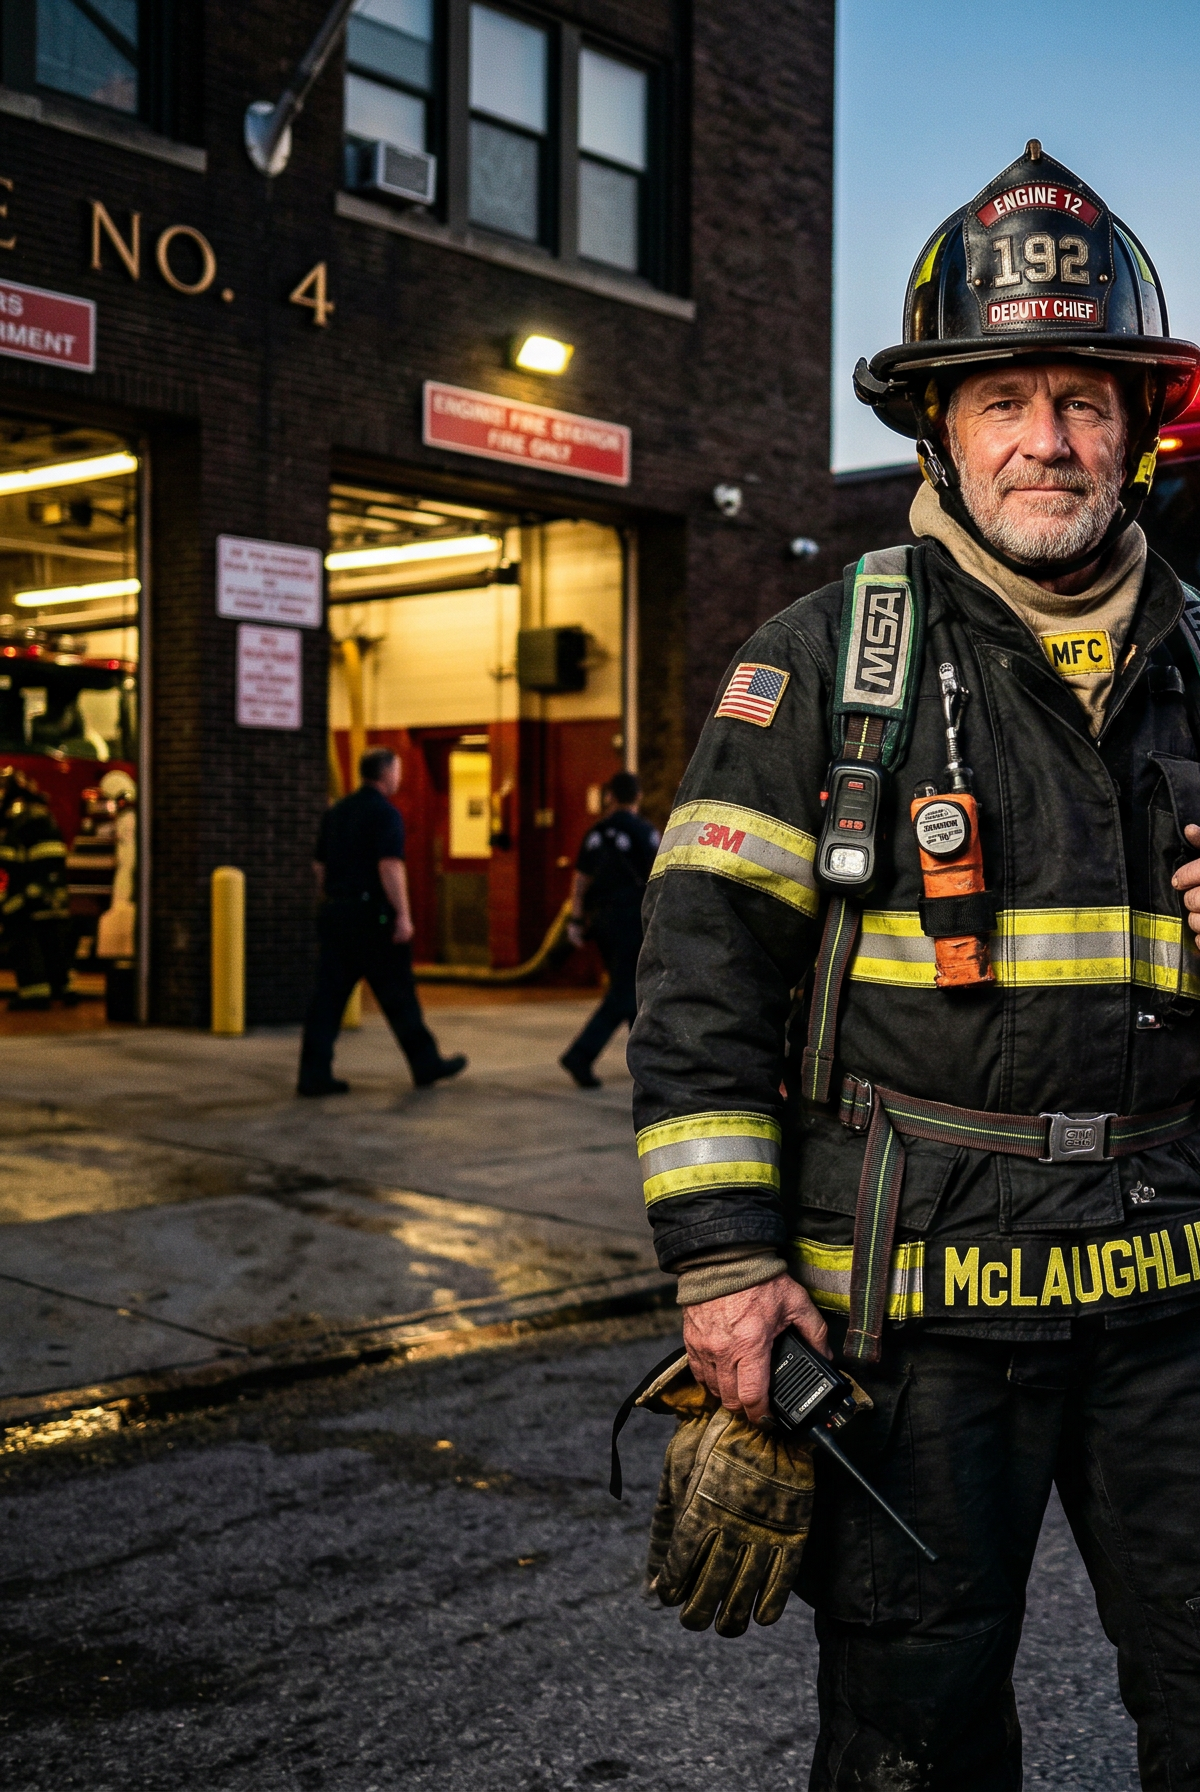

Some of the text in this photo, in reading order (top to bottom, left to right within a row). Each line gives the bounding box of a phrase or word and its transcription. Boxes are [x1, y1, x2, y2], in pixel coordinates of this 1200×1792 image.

[993, 186, 1084, 215] ENGINE 12
[90, 200, 236, 303] NO.
[289, 260, 335, 326] 4
[992, 231, 1090, 289] 192
[991, 299, 1094, 323] DEPUTY CHIEF
[860, 592, 902, 688] MSA
[1051, 638, 1104, 668] MFC
[697, 822, 747, 855] 3M
